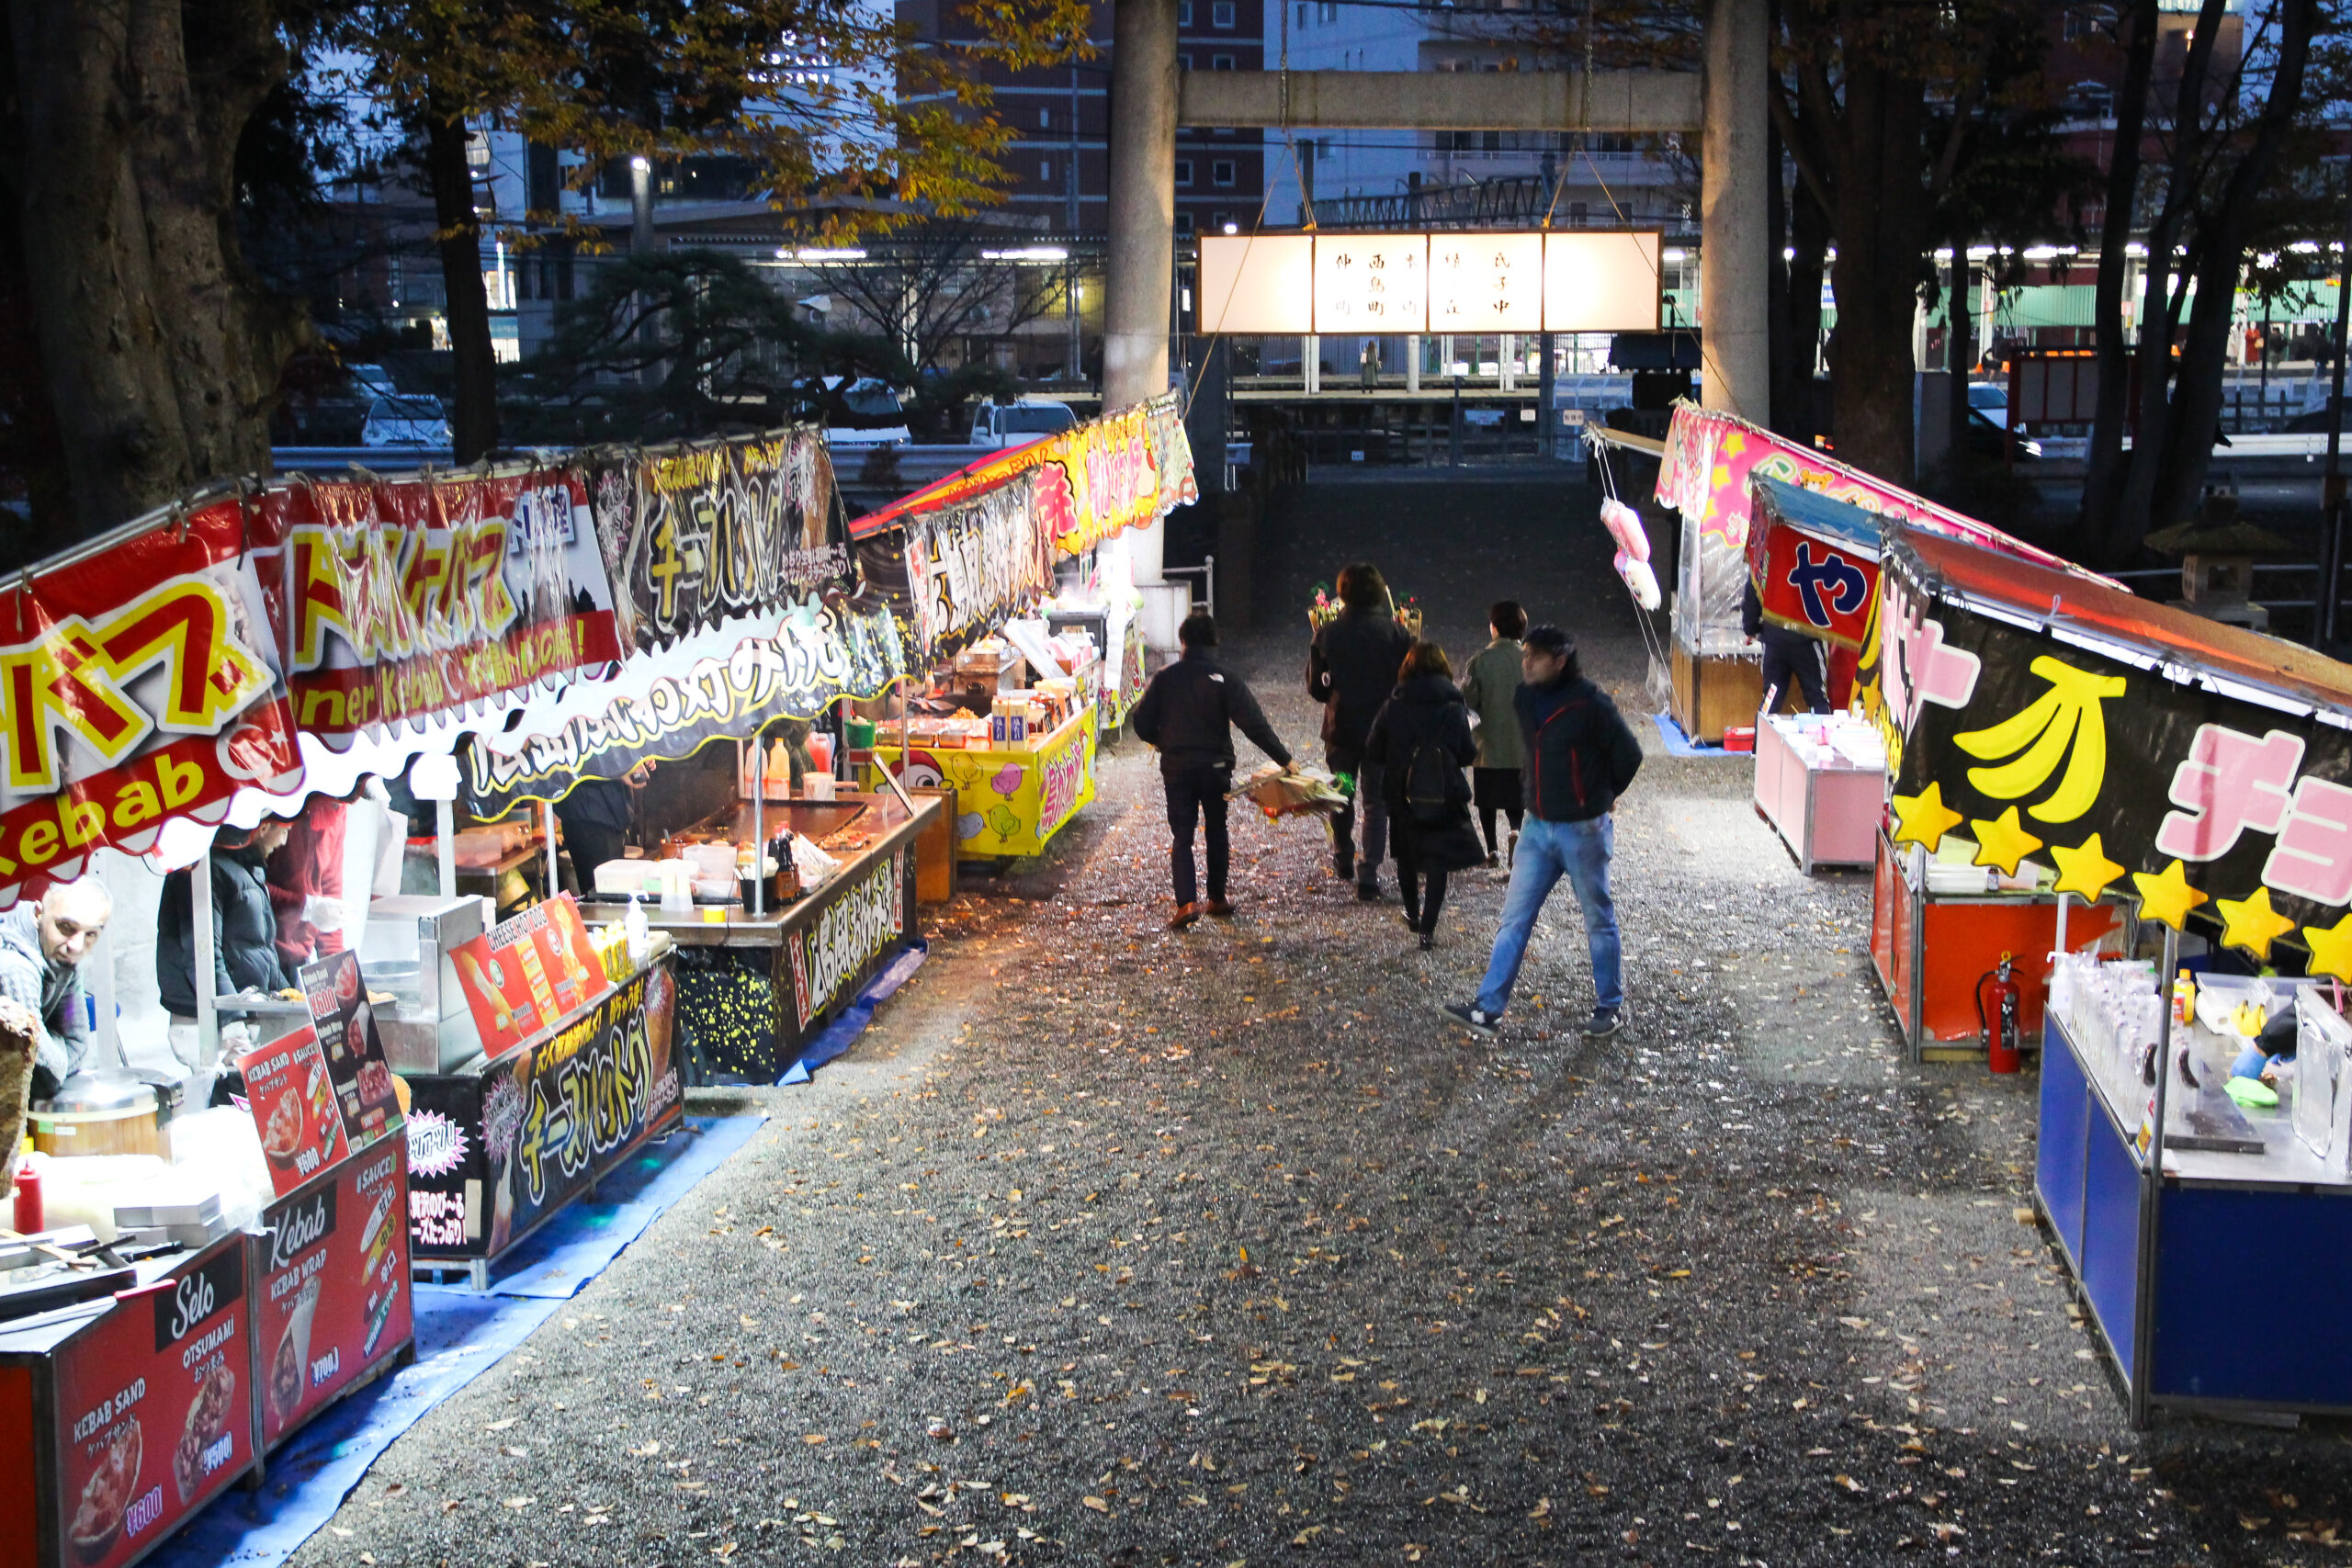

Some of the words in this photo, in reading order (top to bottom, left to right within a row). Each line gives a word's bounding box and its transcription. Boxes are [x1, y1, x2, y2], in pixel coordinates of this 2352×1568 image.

[1368, 254, 1385, 315] 西島町
[1493, 253, 1510, 314] 氏子中
[381, 665, 444, 716] Kebab
[486, 920, 519, 953] CHEESE
[516, 913, 532, 938] HOT
[530, 906, 548, 931] DOG
[246, 1060, 272, 1084] KEBAB
[270, 1052, 290, 1075] SAND
[258, 1073, 288, 1096] ケバブサンド
[296, 1146, 321, 1177] ¥600
[361, 1156, 392, 1190] SAUCE
[379, 1182, 396, 1218] 甘口
[270, 1194, 326, 1273] Kebab
[379, 1214, 396, 1247] 中辛
[270, 1264, 300, 1302] KEBAB
[301, 1247, 327, 1280] WRAP
[379, 1249, 397, 1284] 辛口
[172, 1271, 215, 1340] Selo
[182, 1314, 235, 1369] OTSUMAMI
[193, 1350, 225, 1382] おつまみ
[74, 1402, 112, 1444] KEBAB
[114, 1376, 147, 1412] SAND
[86, 1413, 136, 1458] ケバブサンド
[126, 1483, 163, 1539] ¥600
